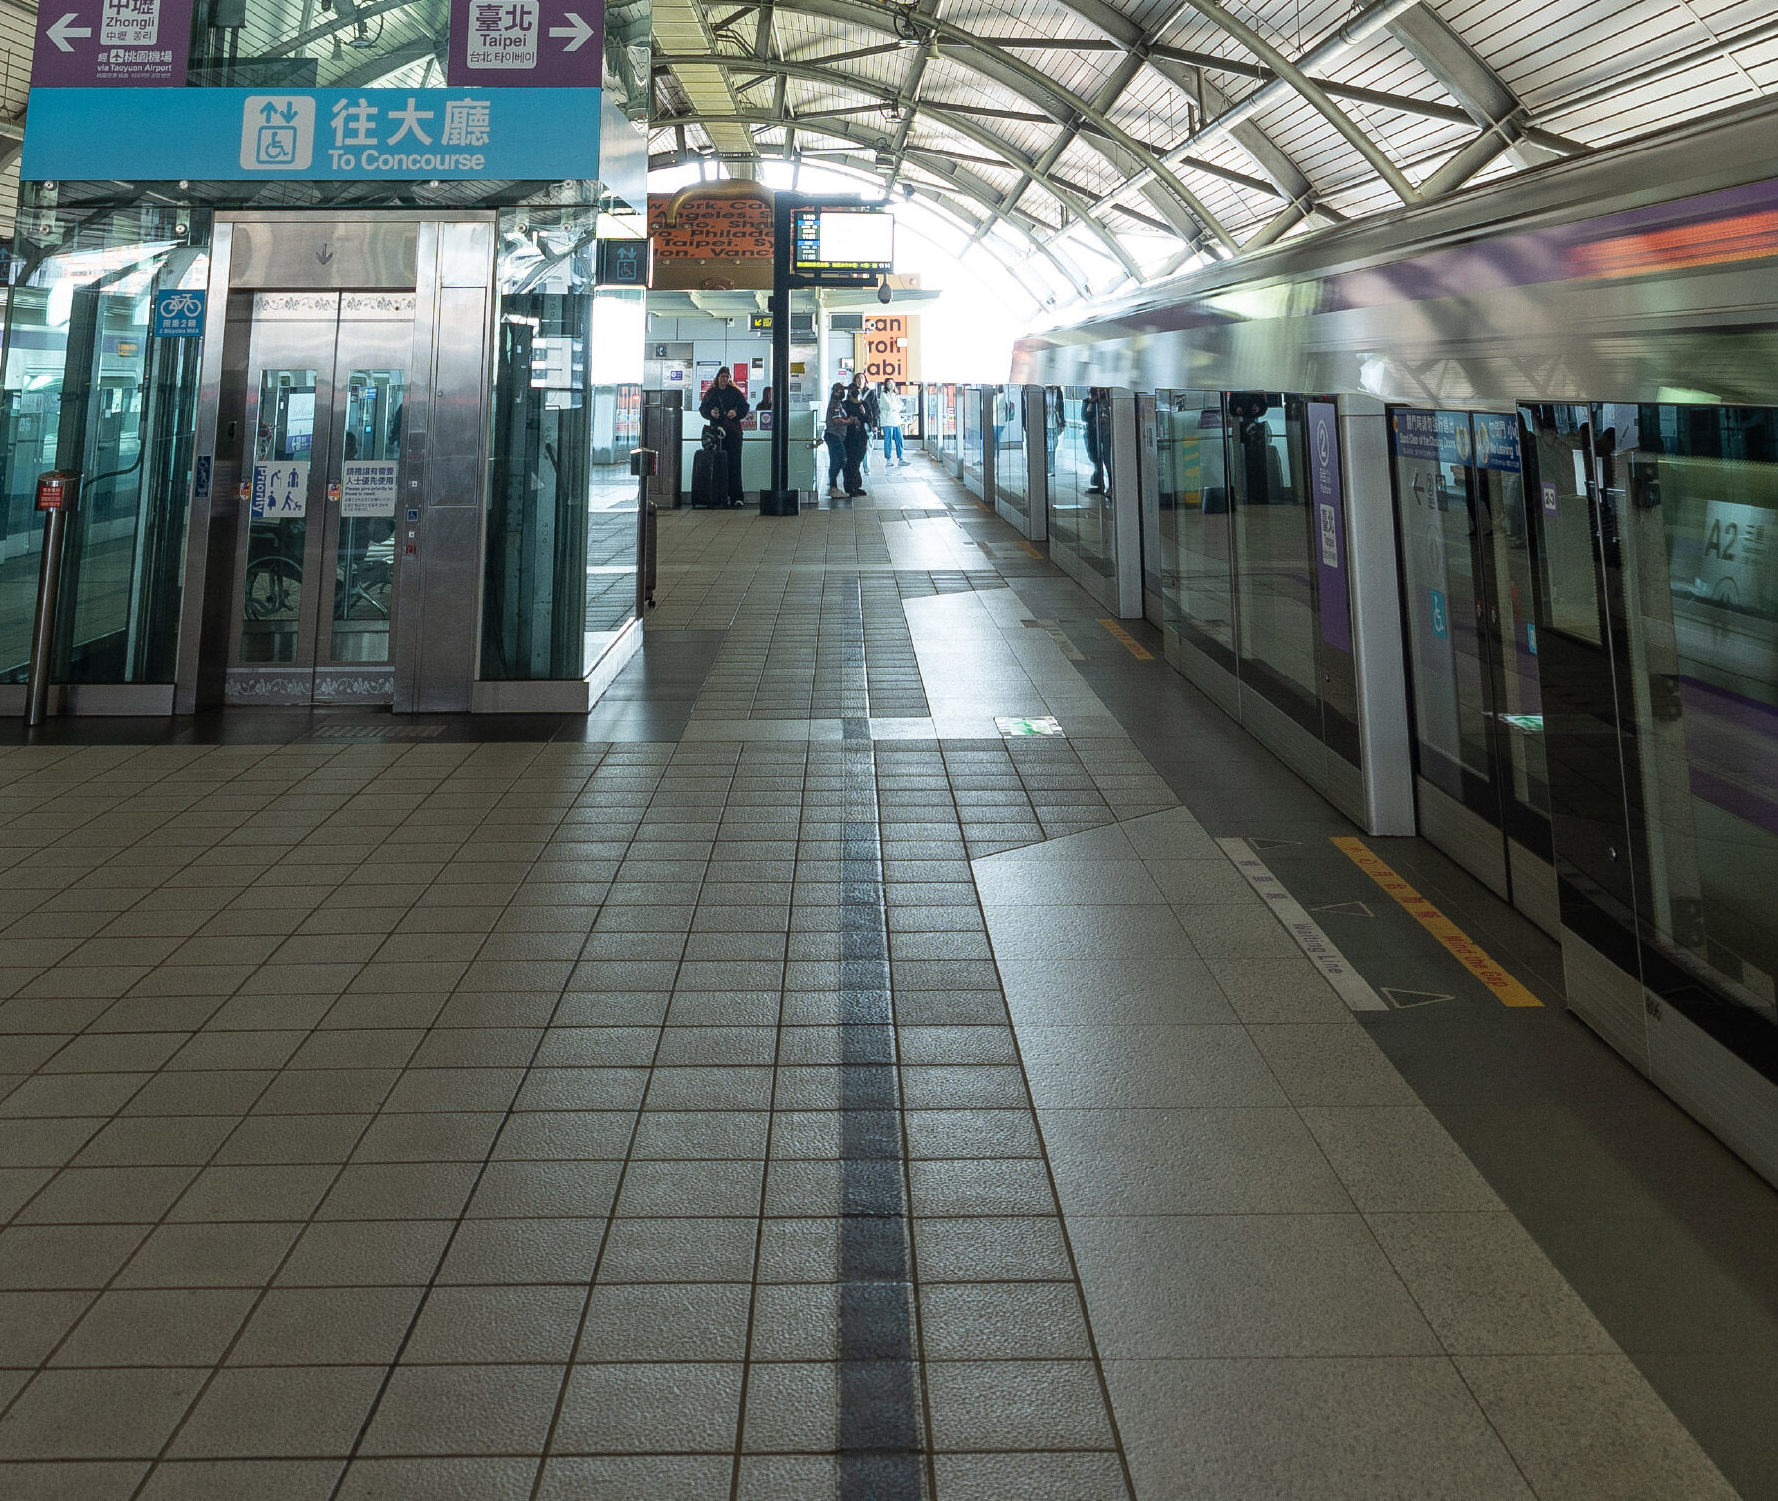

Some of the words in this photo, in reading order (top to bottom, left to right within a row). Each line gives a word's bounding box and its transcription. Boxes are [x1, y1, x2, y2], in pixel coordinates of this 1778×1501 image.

[106, 16, 155, 30] Zhongli
[475, 3, 532, 31] 臺北
[480, 33, 526, 50] Taipei
[124, 50, 173, 63] 桃園機場
[470, 50, 492, 62] 台北
[494, 51, 535, 63] 타이베이
[110, 64, 143, 72] Taoyuan
[145, 64, 172, 72] Airport
[330, 97, 491, 147] 往大廳
[328, 150, 356, 170] To
[361, 150, 486, 170] Concourse
[663, 238, 739, 249] Taipei.
[710, 248, 774, 257] Vanc
[253, 466, 266, 512] Priority
[1704, 518, 1739, 562] A2
[1292, 922, 1327, 953] Waiting
[1317, 955, 1343, 974] Line
[1480, 971, 1510, 987] Gap
